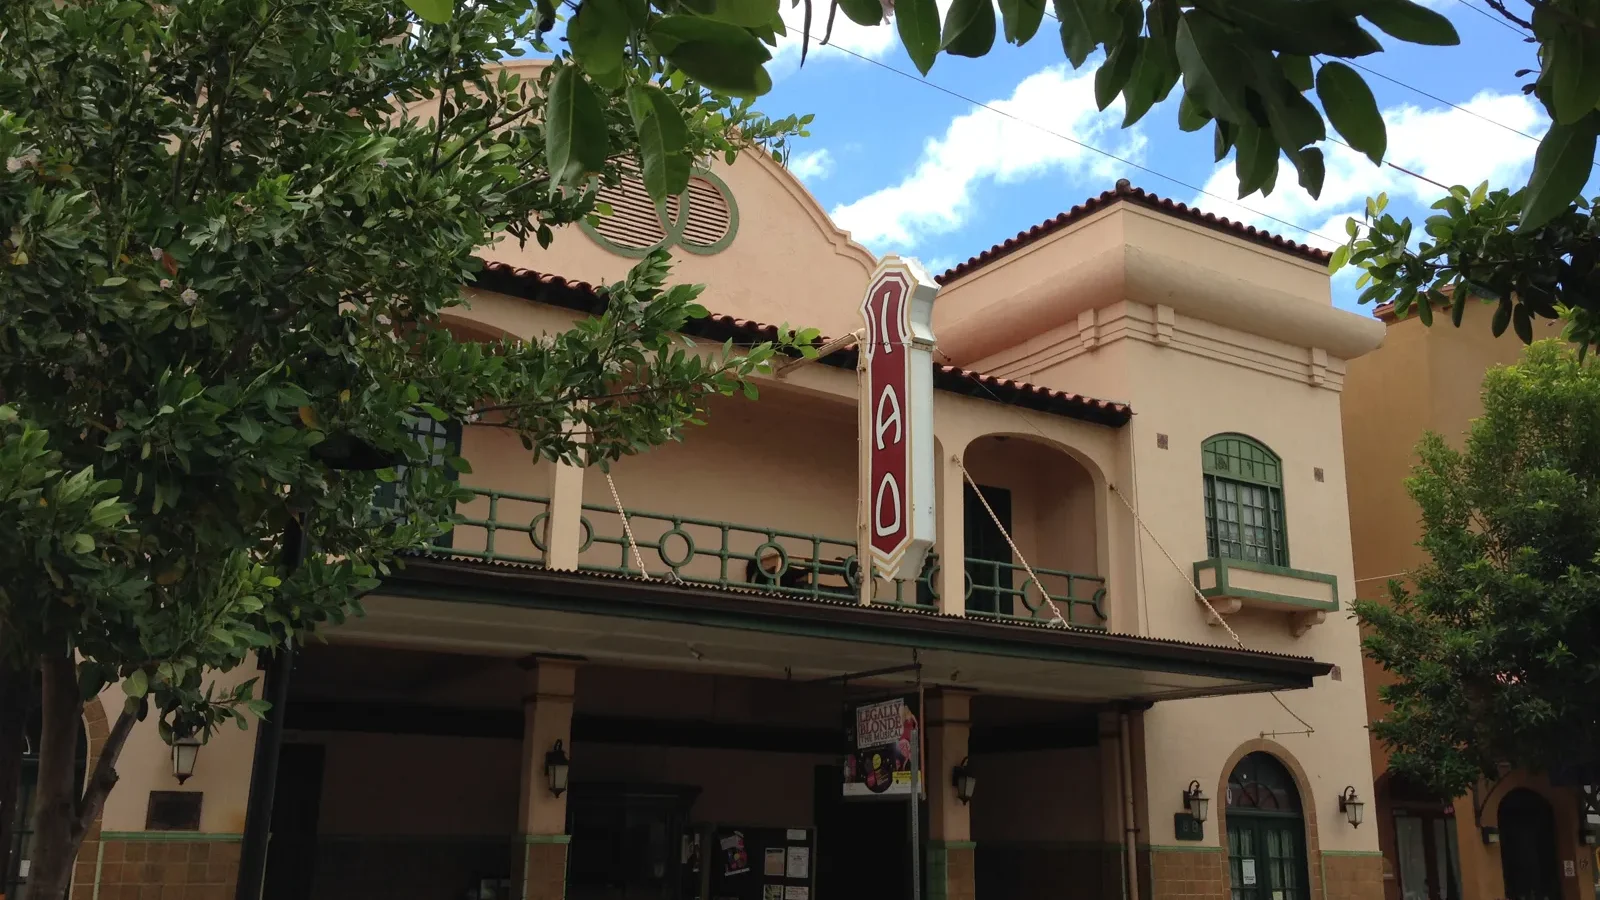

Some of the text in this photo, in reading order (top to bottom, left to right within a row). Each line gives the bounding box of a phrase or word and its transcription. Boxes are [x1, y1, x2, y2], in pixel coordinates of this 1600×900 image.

[876, 291, 902, 537] IAO
[860, 702, 901, 722] LEGALLY
[860, 715, 902, 736] BLONDE
[860, 729, 902, 743] THE MUSICAL
